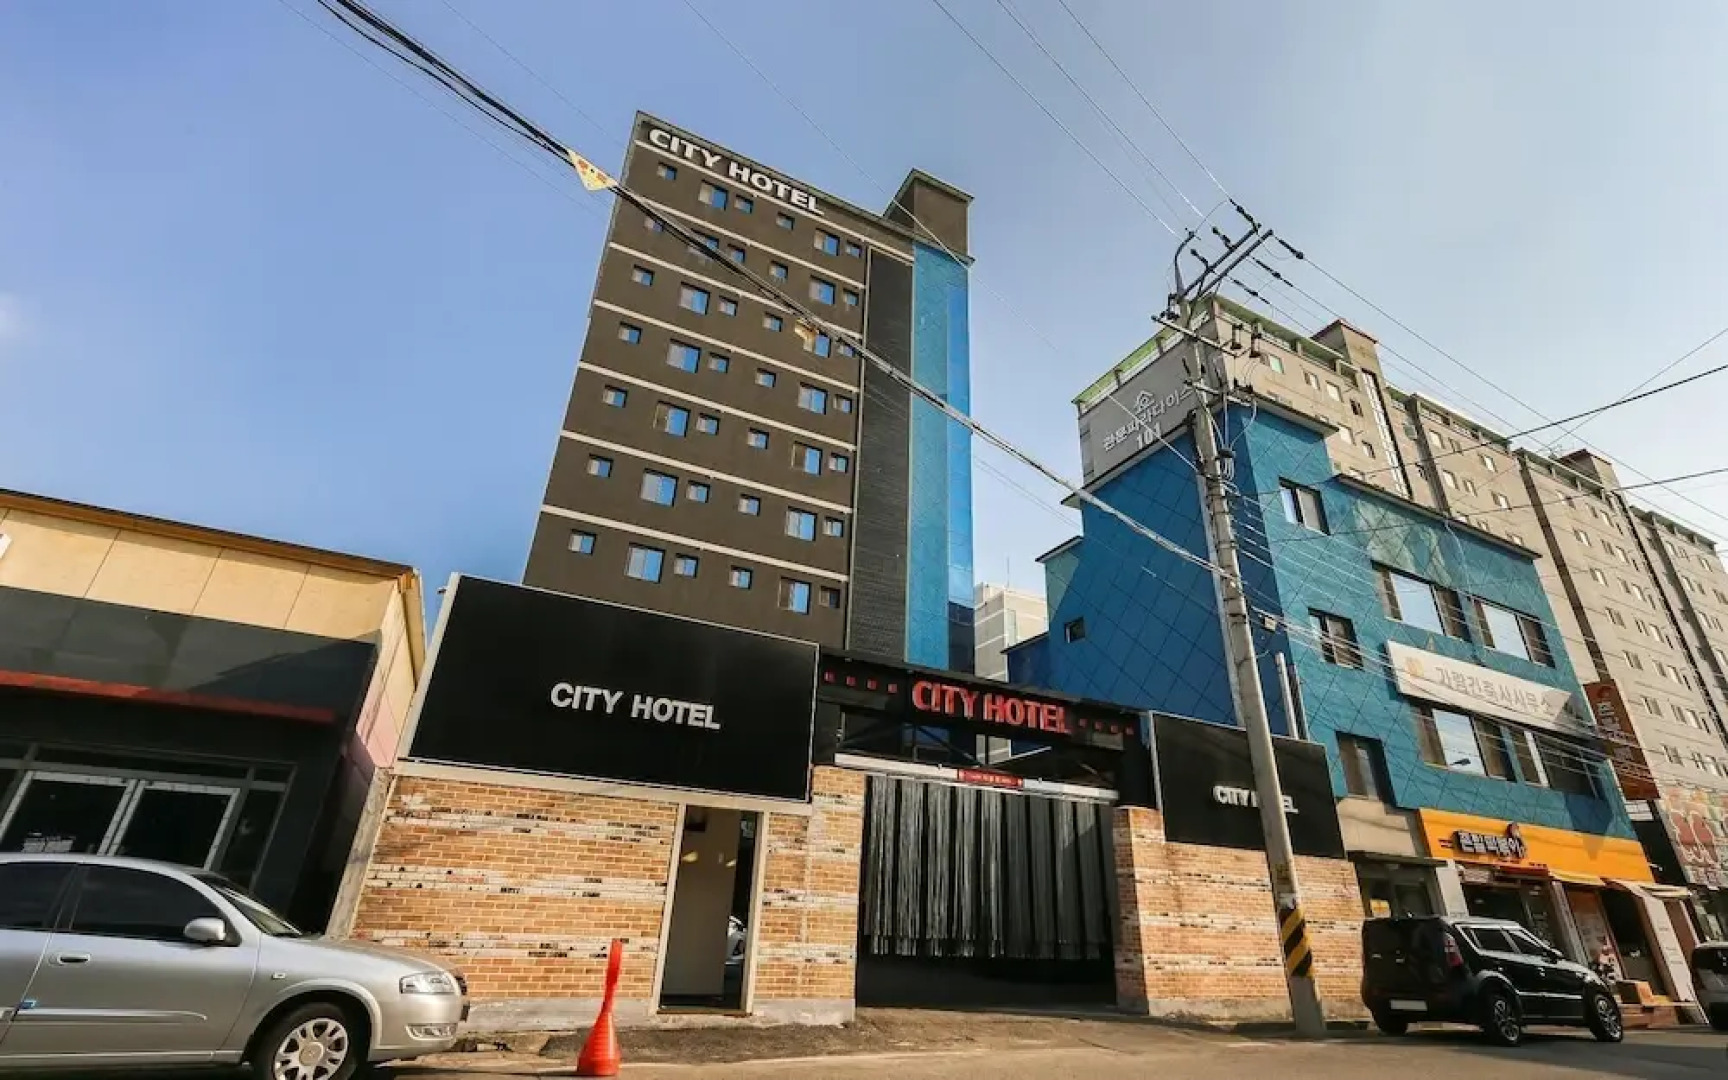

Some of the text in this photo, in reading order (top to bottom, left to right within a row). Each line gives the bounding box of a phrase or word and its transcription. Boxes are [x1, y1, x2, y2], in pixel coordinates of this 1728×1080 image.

[650, 129, 824, 215] CITY HOTEL
[1137, 422, 1161, 450] 101
[551, 682, 721, 730] CITY HOTEL
[912, 680, 1071, 734] CITY HOTEL
[1213, 785, 1250, 807] CITY
